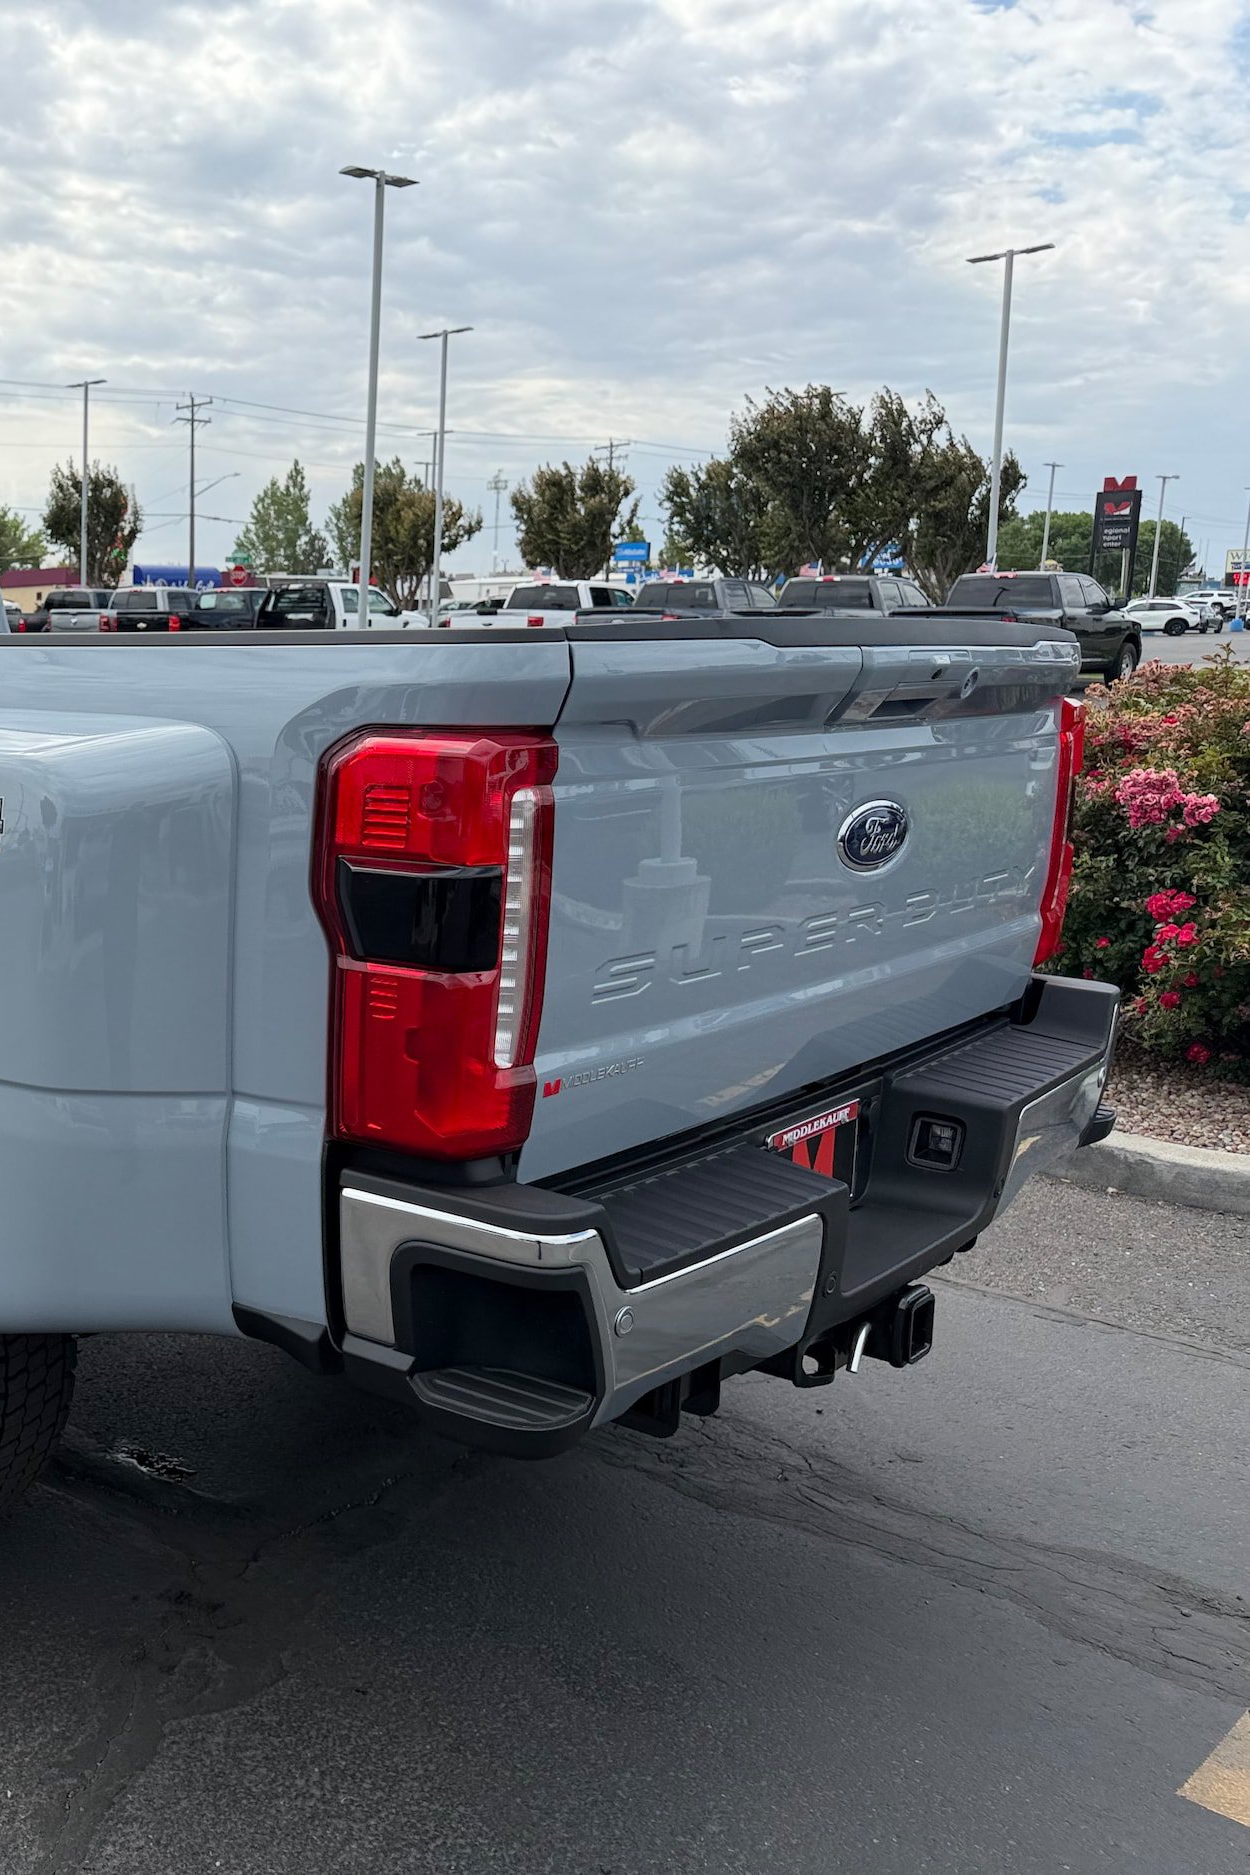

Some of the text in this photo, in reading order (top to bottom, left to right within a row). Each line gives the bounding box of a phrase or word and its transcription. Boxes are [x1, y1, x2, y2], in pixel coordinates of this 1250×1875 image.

[1103, 527, 1131, 535] egional
[859, 816, 900, 857] Ford
[591, 865, 1036, 1005] SUPER DUTY
[561, 1056, 646, 1091] MIDDLEKAUFF
[781, 1107, 852, 1147] MIDDLEKAUFF
